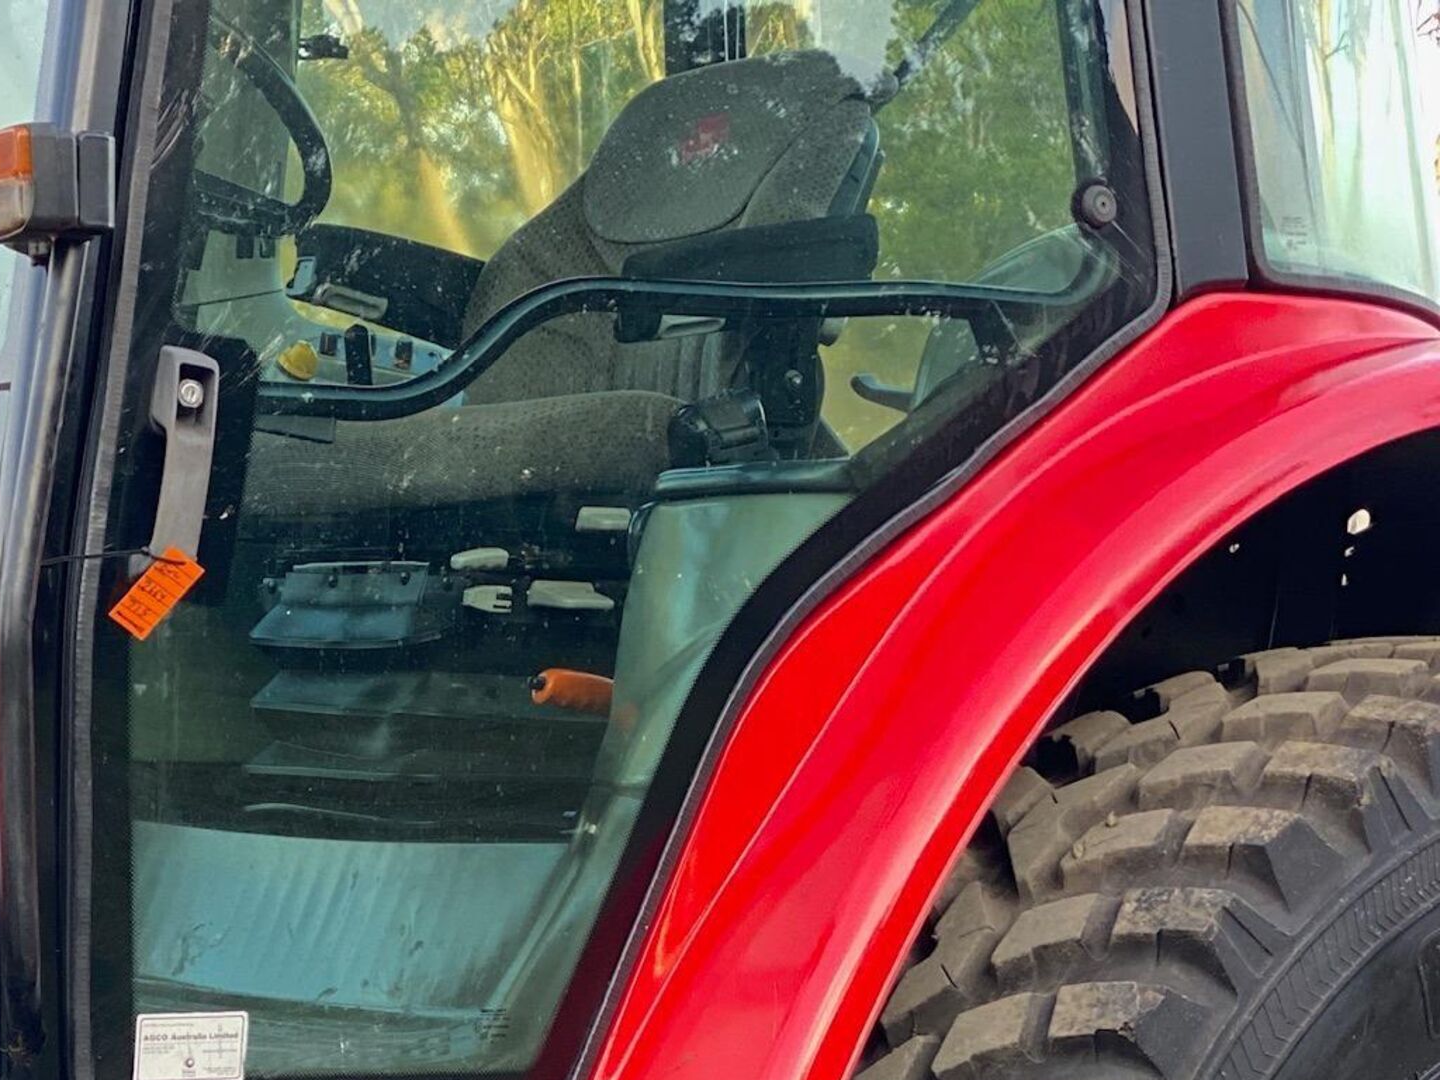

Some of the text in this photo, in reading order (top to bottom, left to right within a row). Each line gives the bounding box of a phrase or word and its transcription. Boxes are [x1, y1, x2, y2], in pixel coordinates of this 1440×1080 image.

[144, 1031, 239, 1041] AGCO Australia Limited
